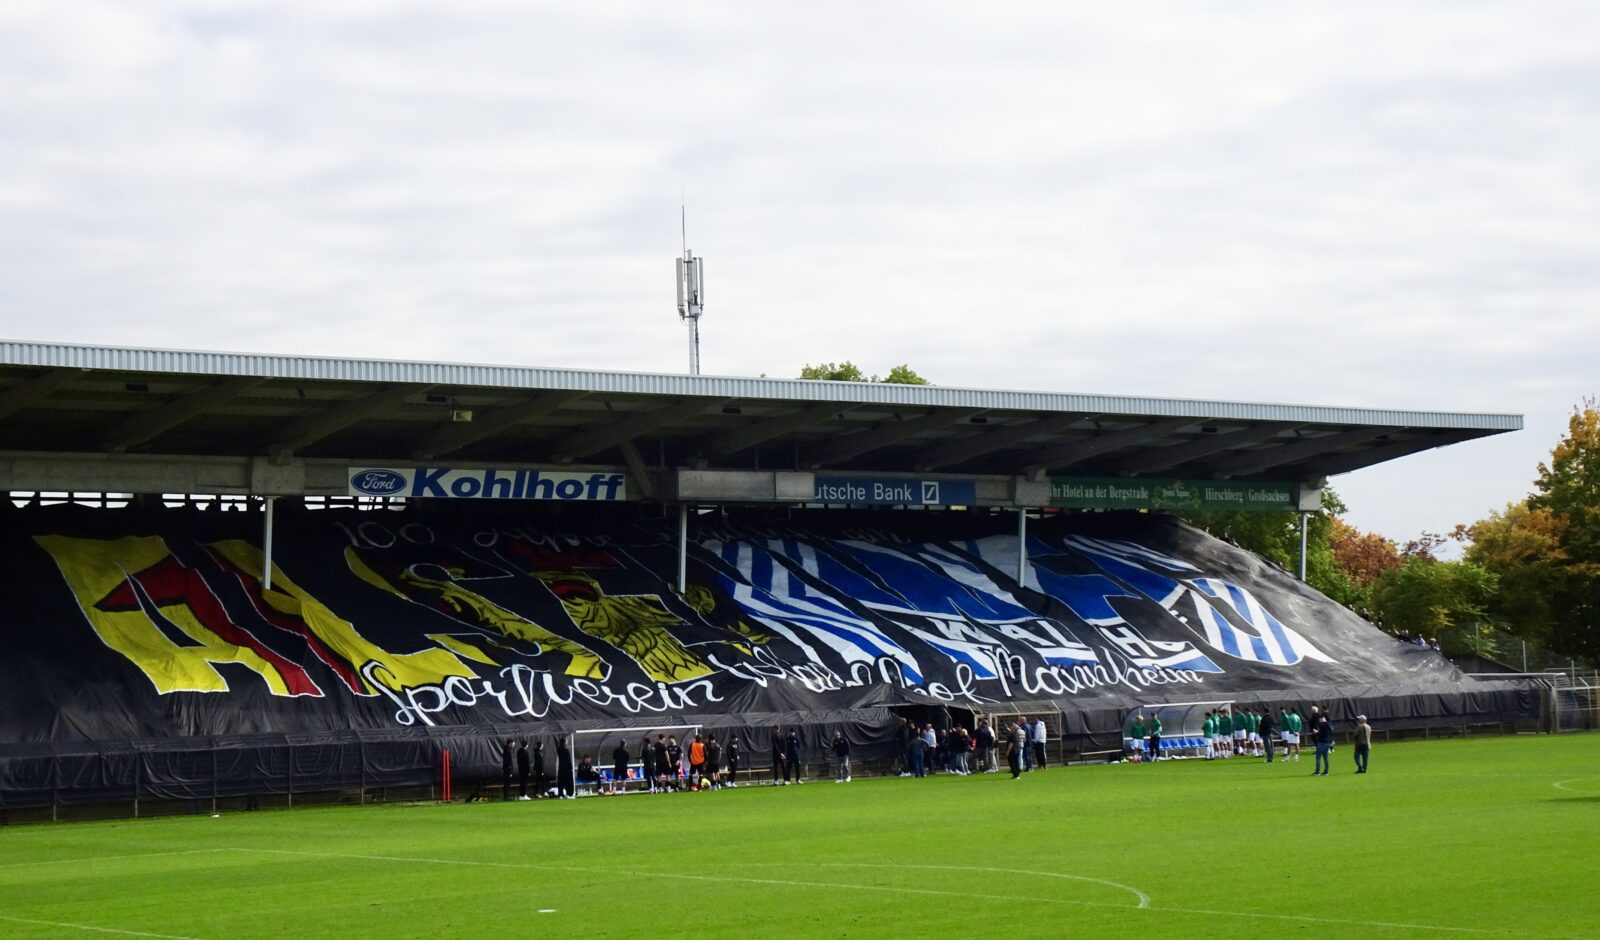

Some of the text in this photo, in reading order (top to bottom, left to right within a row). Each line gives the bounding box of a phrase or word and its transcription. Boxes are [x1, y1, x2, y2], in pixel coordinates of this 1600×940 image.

[361, 472, 395, 490] Ford
[411, 467, 624, 500] Kohlhoff
[874, 482, 912, 500] Bank
[1063, 484, 1083, 498] Hotel
[1085, 488, 1094, 498] an
[1096, 485, 1107, 498] der
[1205, 487, 1243, 503] Hirschberg
[987, 645, 1204, 698] Mannheim
